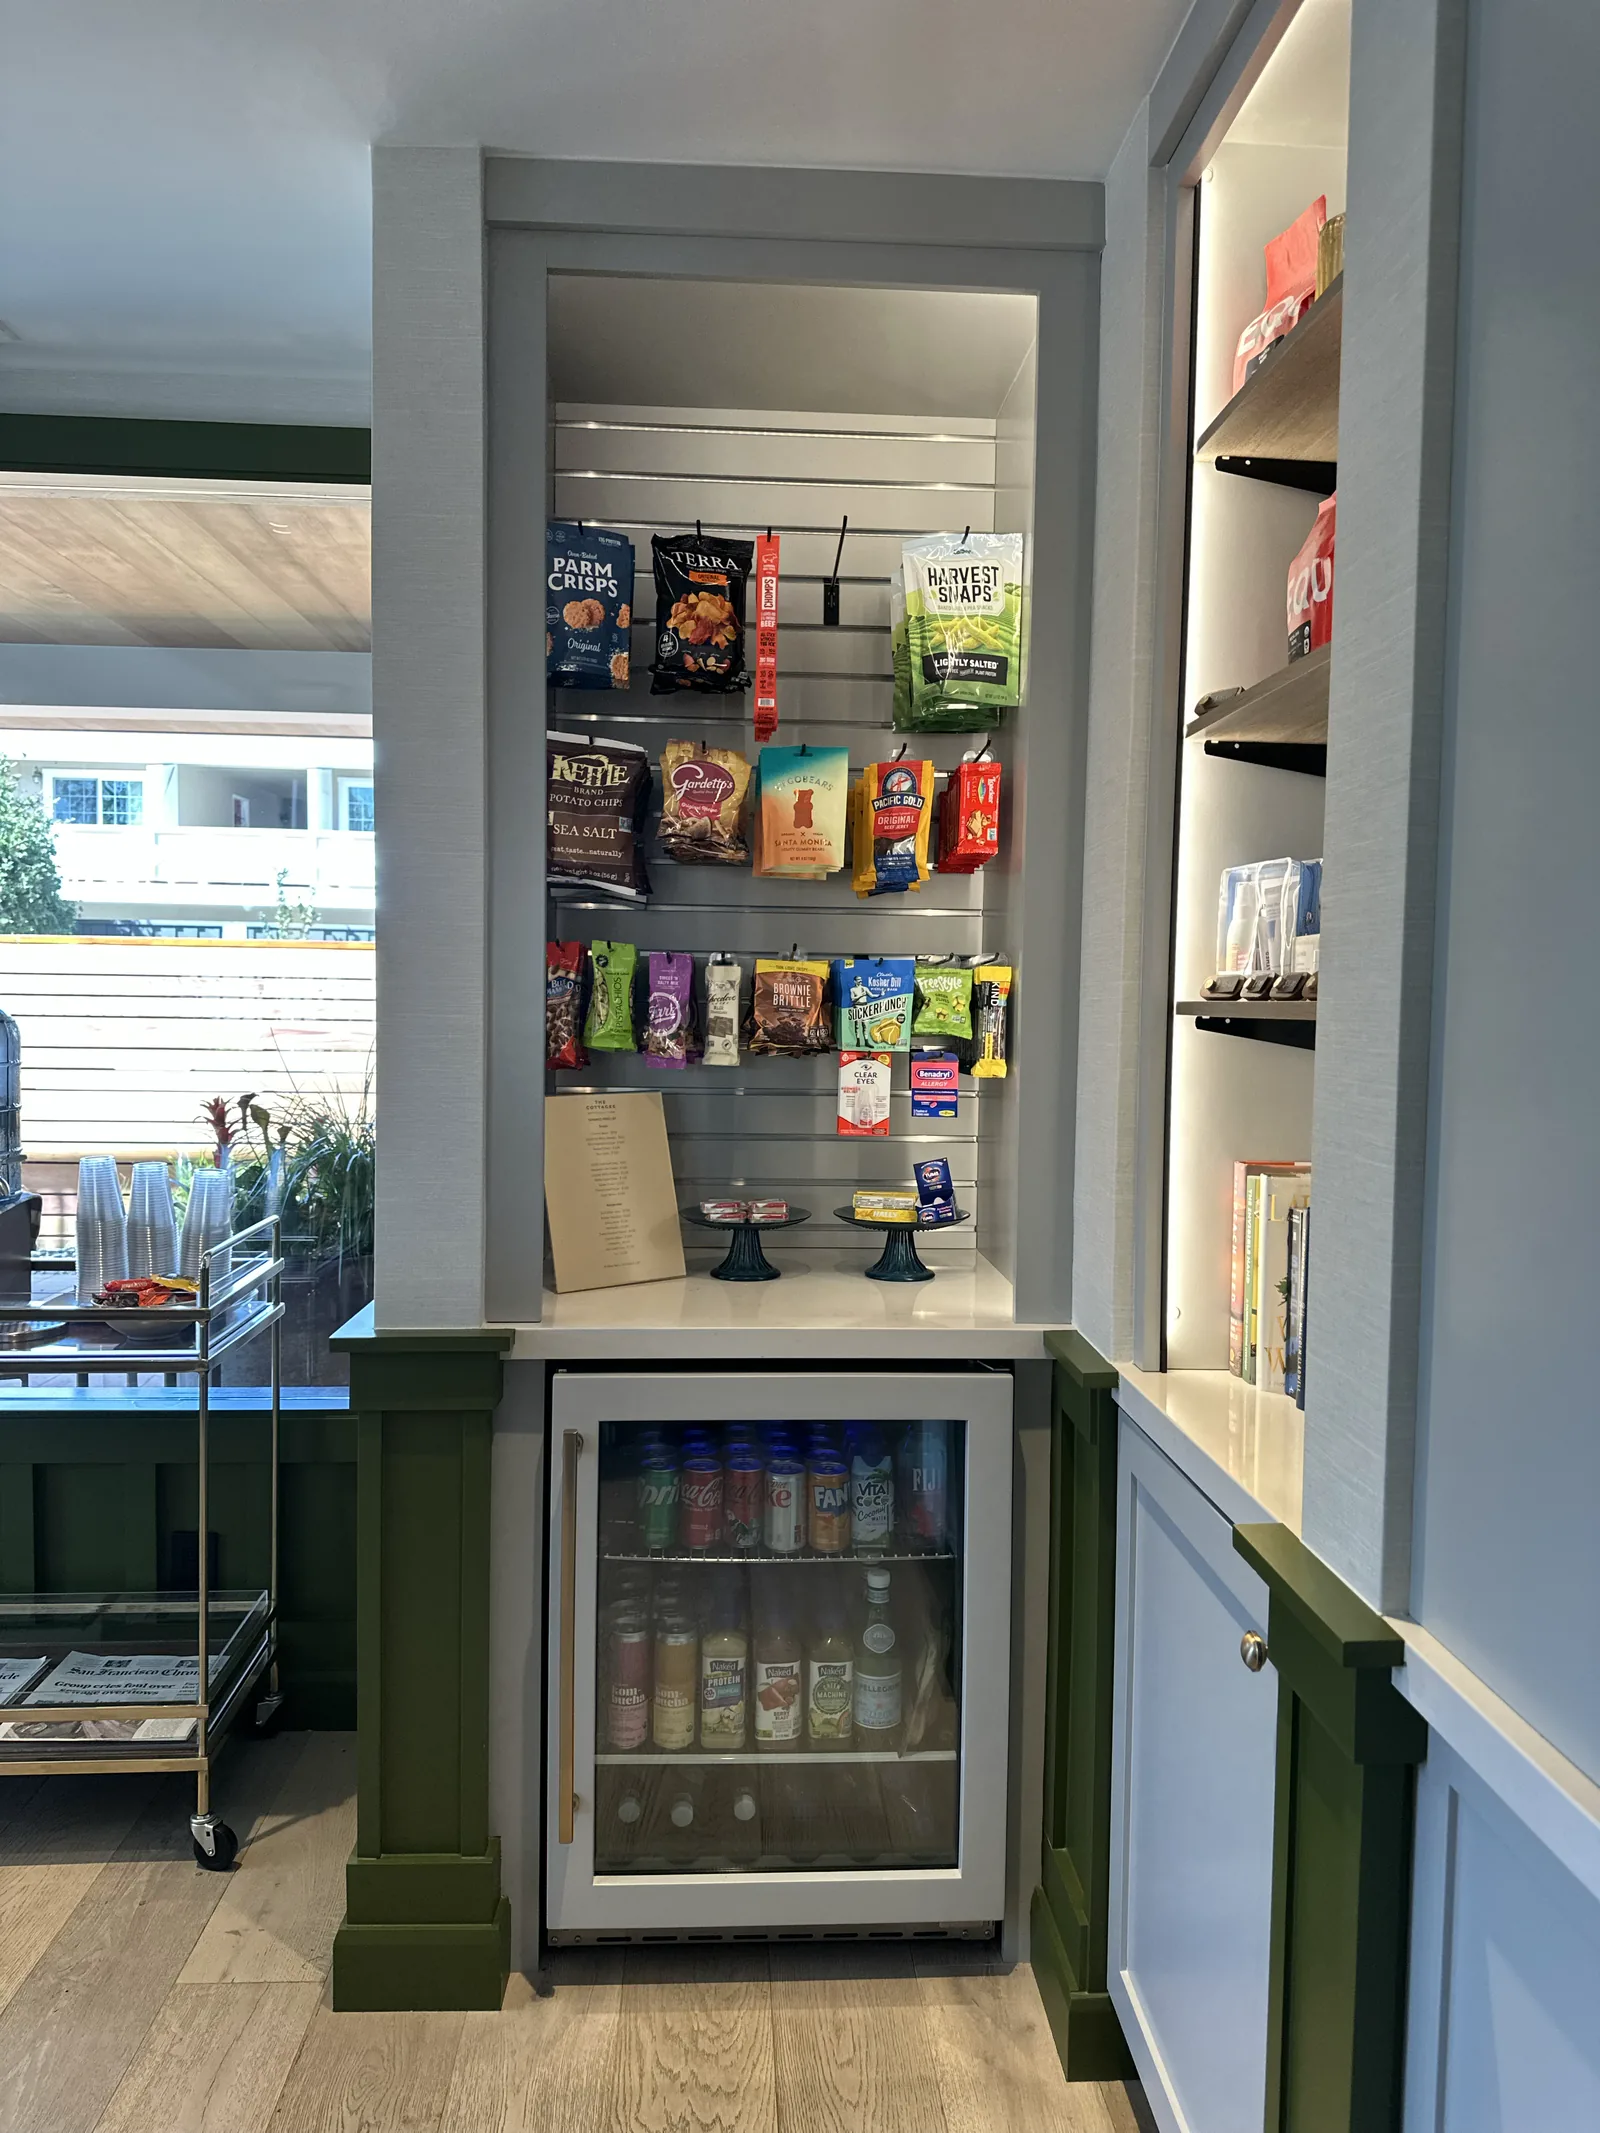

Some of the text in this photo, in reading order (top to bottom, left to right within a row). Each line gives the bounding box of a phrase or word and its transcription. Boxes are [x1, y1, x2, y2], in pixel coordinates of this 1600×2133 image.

[553, 557, 612, 578] PARM
[671, 551, 738, 571] TERRA
[927, 566, 999, 587] HARVEST
[547, 573, 618, 598] CRISPS
[764, 578, 774, 609] CHOMPS
[938, 584, 992, 603] SNAPS
[760, 620, 776, 628] BEEF
[567, 637, 601, 652] Original
[935, 658, 968, 668] LIGTLY
[548, 753, 630, 787] KETTLE
[671, 763, 734, 801] Gardetto's
[775, 775, 834, 792] EGOBEARS
[573, 786, 604, 796] BRAND
[549, 793, 623, 808] POTATO CHIPS
[873, 795, 923, 810] PACIFIC GOLD
[877, 815, 916, 825] ORIGINAL
[552, 823, 618, 839] SEA SALT
[774, 839, 798, 847] SANTA
[867, 976, 902, 988] Kosher Dill
[773, 982, 811, 996] BROWNIE
[991, 981, 1001, 1006] KIND
[772, 994, 812, 1008] BRITTLE
[853, 1071, 878, 1079] CLEAR
[919, 1070, 950, 1080] Benadryl
[924, 1171, 940, 1179] TUMS
[872, 1210, 898, 1218] HALLS
[912, 1467, 942, 1492] FIJI
[857, 1481, 887, 1496] VITA
[814, 1482, 850, 1509] FAN
[856, 1495, 890, 1507] COCO
[857, 1505, 887, 1521] Coconut
[66, 1666, 94, 1676] San
[94, 1668, 159, 1676] Francisco
[712, 1661, 736, 1672] Naked
[767, 1666, 792, 1677] Naked
[820, 1665, 845, 1676] Naked
[54, 1681, 92, 1689] Group
[707, 1675, 741, 1688] PROTEIN
[59, 1688, 101, 1696] sewage
[816, 1691, 848, 1699] MACHINE
[611, 1694, 646, 1705] bucha
